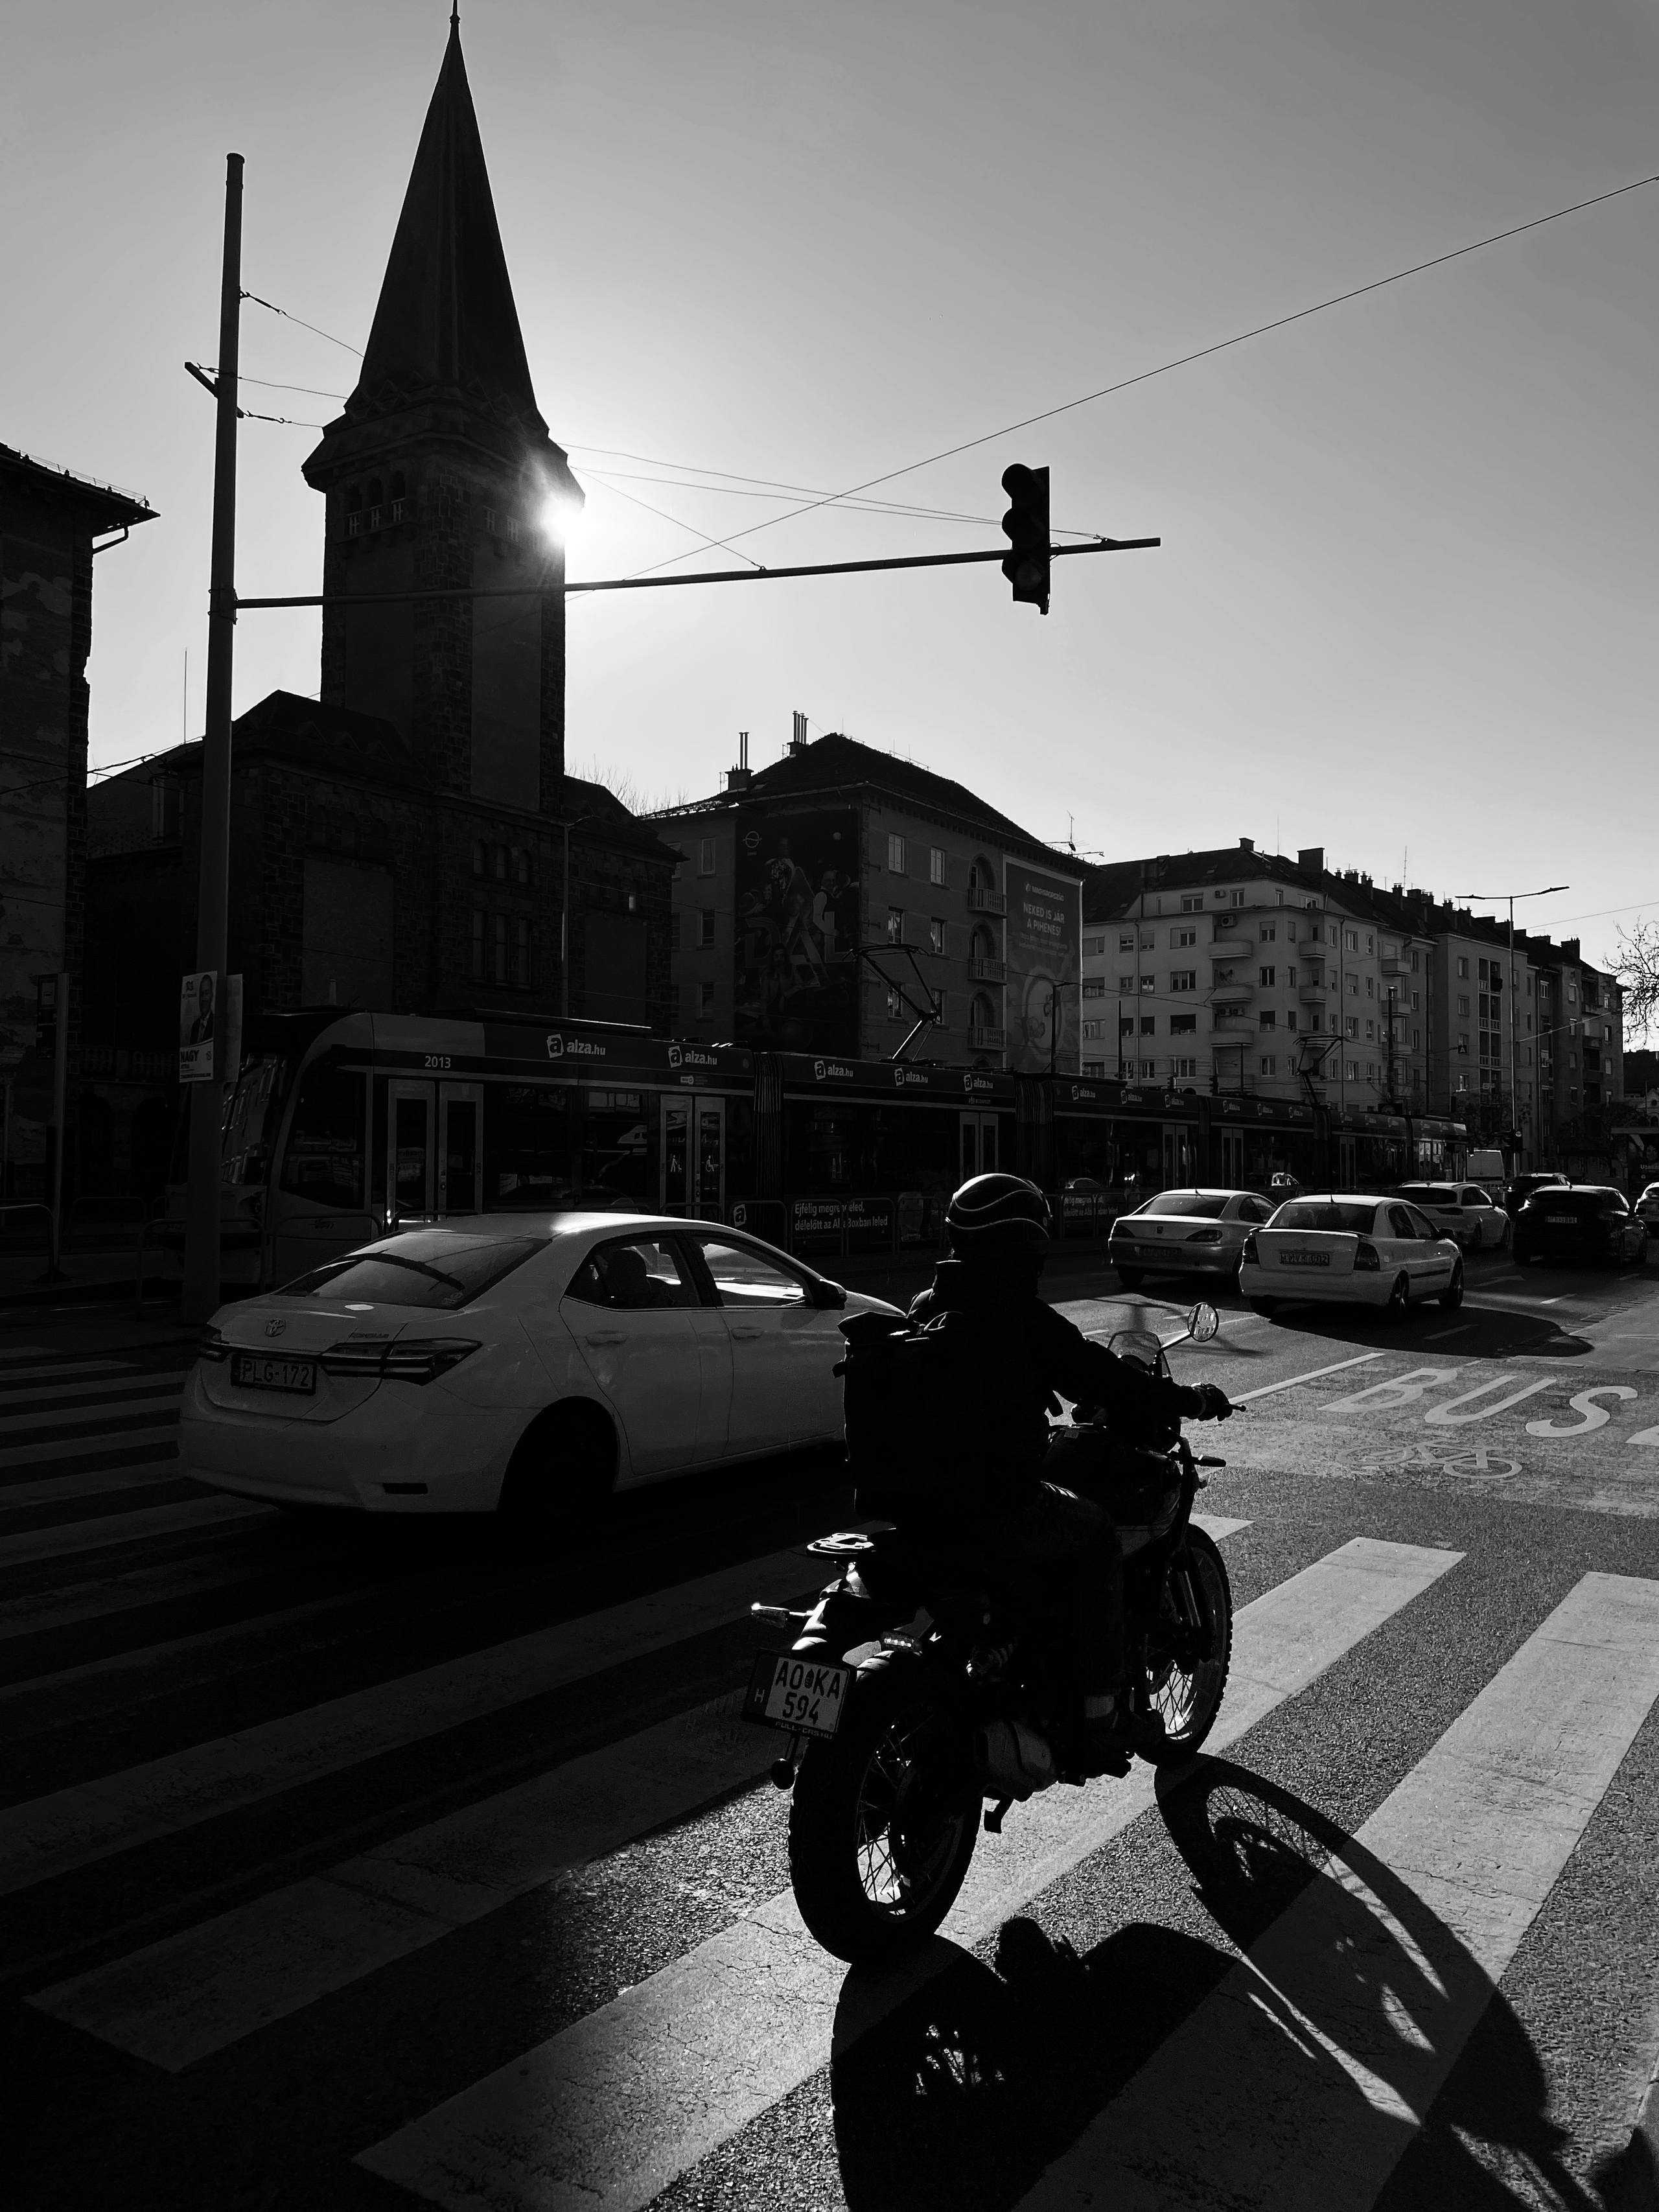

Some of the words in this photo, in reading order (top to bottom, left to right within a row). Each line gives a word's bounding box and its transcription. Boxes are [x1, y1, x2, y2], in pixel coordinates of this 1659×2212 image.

[1023, 902, 1044, 918] NEKED
[1046, 909, 1052, 920] IS
[1053, 910, 1065, 924] JÁR
[1027, 918, 1032, 928] A
[1034, 920, 1061, 937] PIHENÉS!
[566, 1040, 606, 1056] alza.hu
[180, 1050, 200, 1062] NAGY
[424, 1056, 451, 1068] 2013
[685, 1050, 717, 1065] alza.hu
[828, 1064, 853, 1077] alza.hu
[905, 1071, 929, 1084] alza.hu
[973, 1077, 993, 1089] alza.hu
[795, 1203, 817, 1217] Ejfélig
[795, 1218, 822, 1231] délelőtt
[824, 1221, 831, 1229] az
[872, 1215, 888, 1226] leled
[242, 1360, 309, 1386] PLG-172
[1316, 1368, 1638, 1438] BUS
[775, 1660, 804, 1690] AO
[813, 1668, 841, 1699] KA
[754, 1688, 765, 1703] H
[782, 1692, 820, 1724] 594
